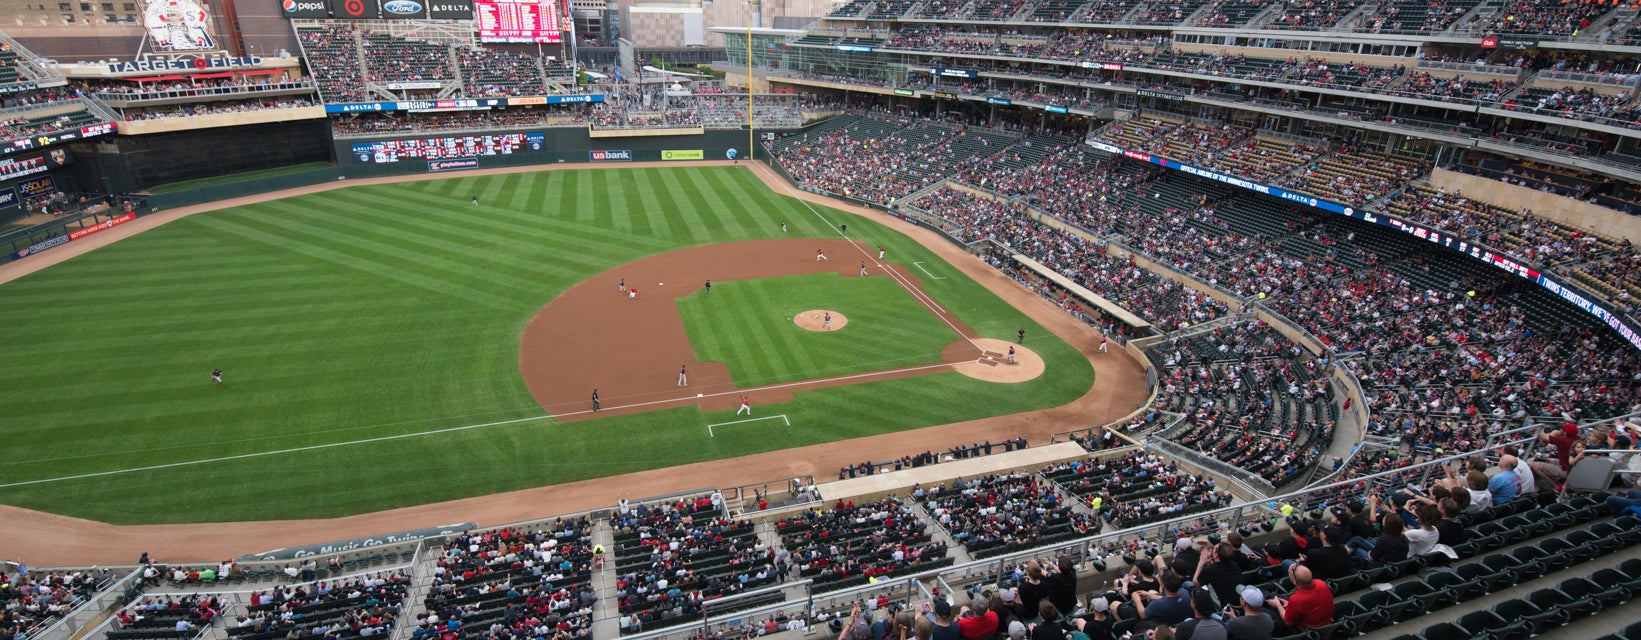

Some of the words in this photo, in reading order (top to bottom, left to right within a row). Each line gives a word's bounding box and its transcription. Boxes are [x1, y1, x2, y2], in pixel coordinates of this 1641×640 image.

[298, 2, 324, 11] pepsi
[391, 3, 414, 12] Ford
[109, 58, 190, 72] TARGET
[211, 56, 262, 68] FIELD
[39, 137, 50, 146] 92
[1180, 165, 1197, 175] OFFICIAL
[1197, 169, 1213, 179] AIRLINE
[1228, 177, 1253, 190] MINNESOTA
[1288, 194, 1308, 203] DELTA
[1542, 278, 1560, 294] TWINS
[1560, 287, 1592, 312] TERRITORY,
[1609, 316, 1620, 330] GOT
[1619, 322, 1632, 340] YOUR
